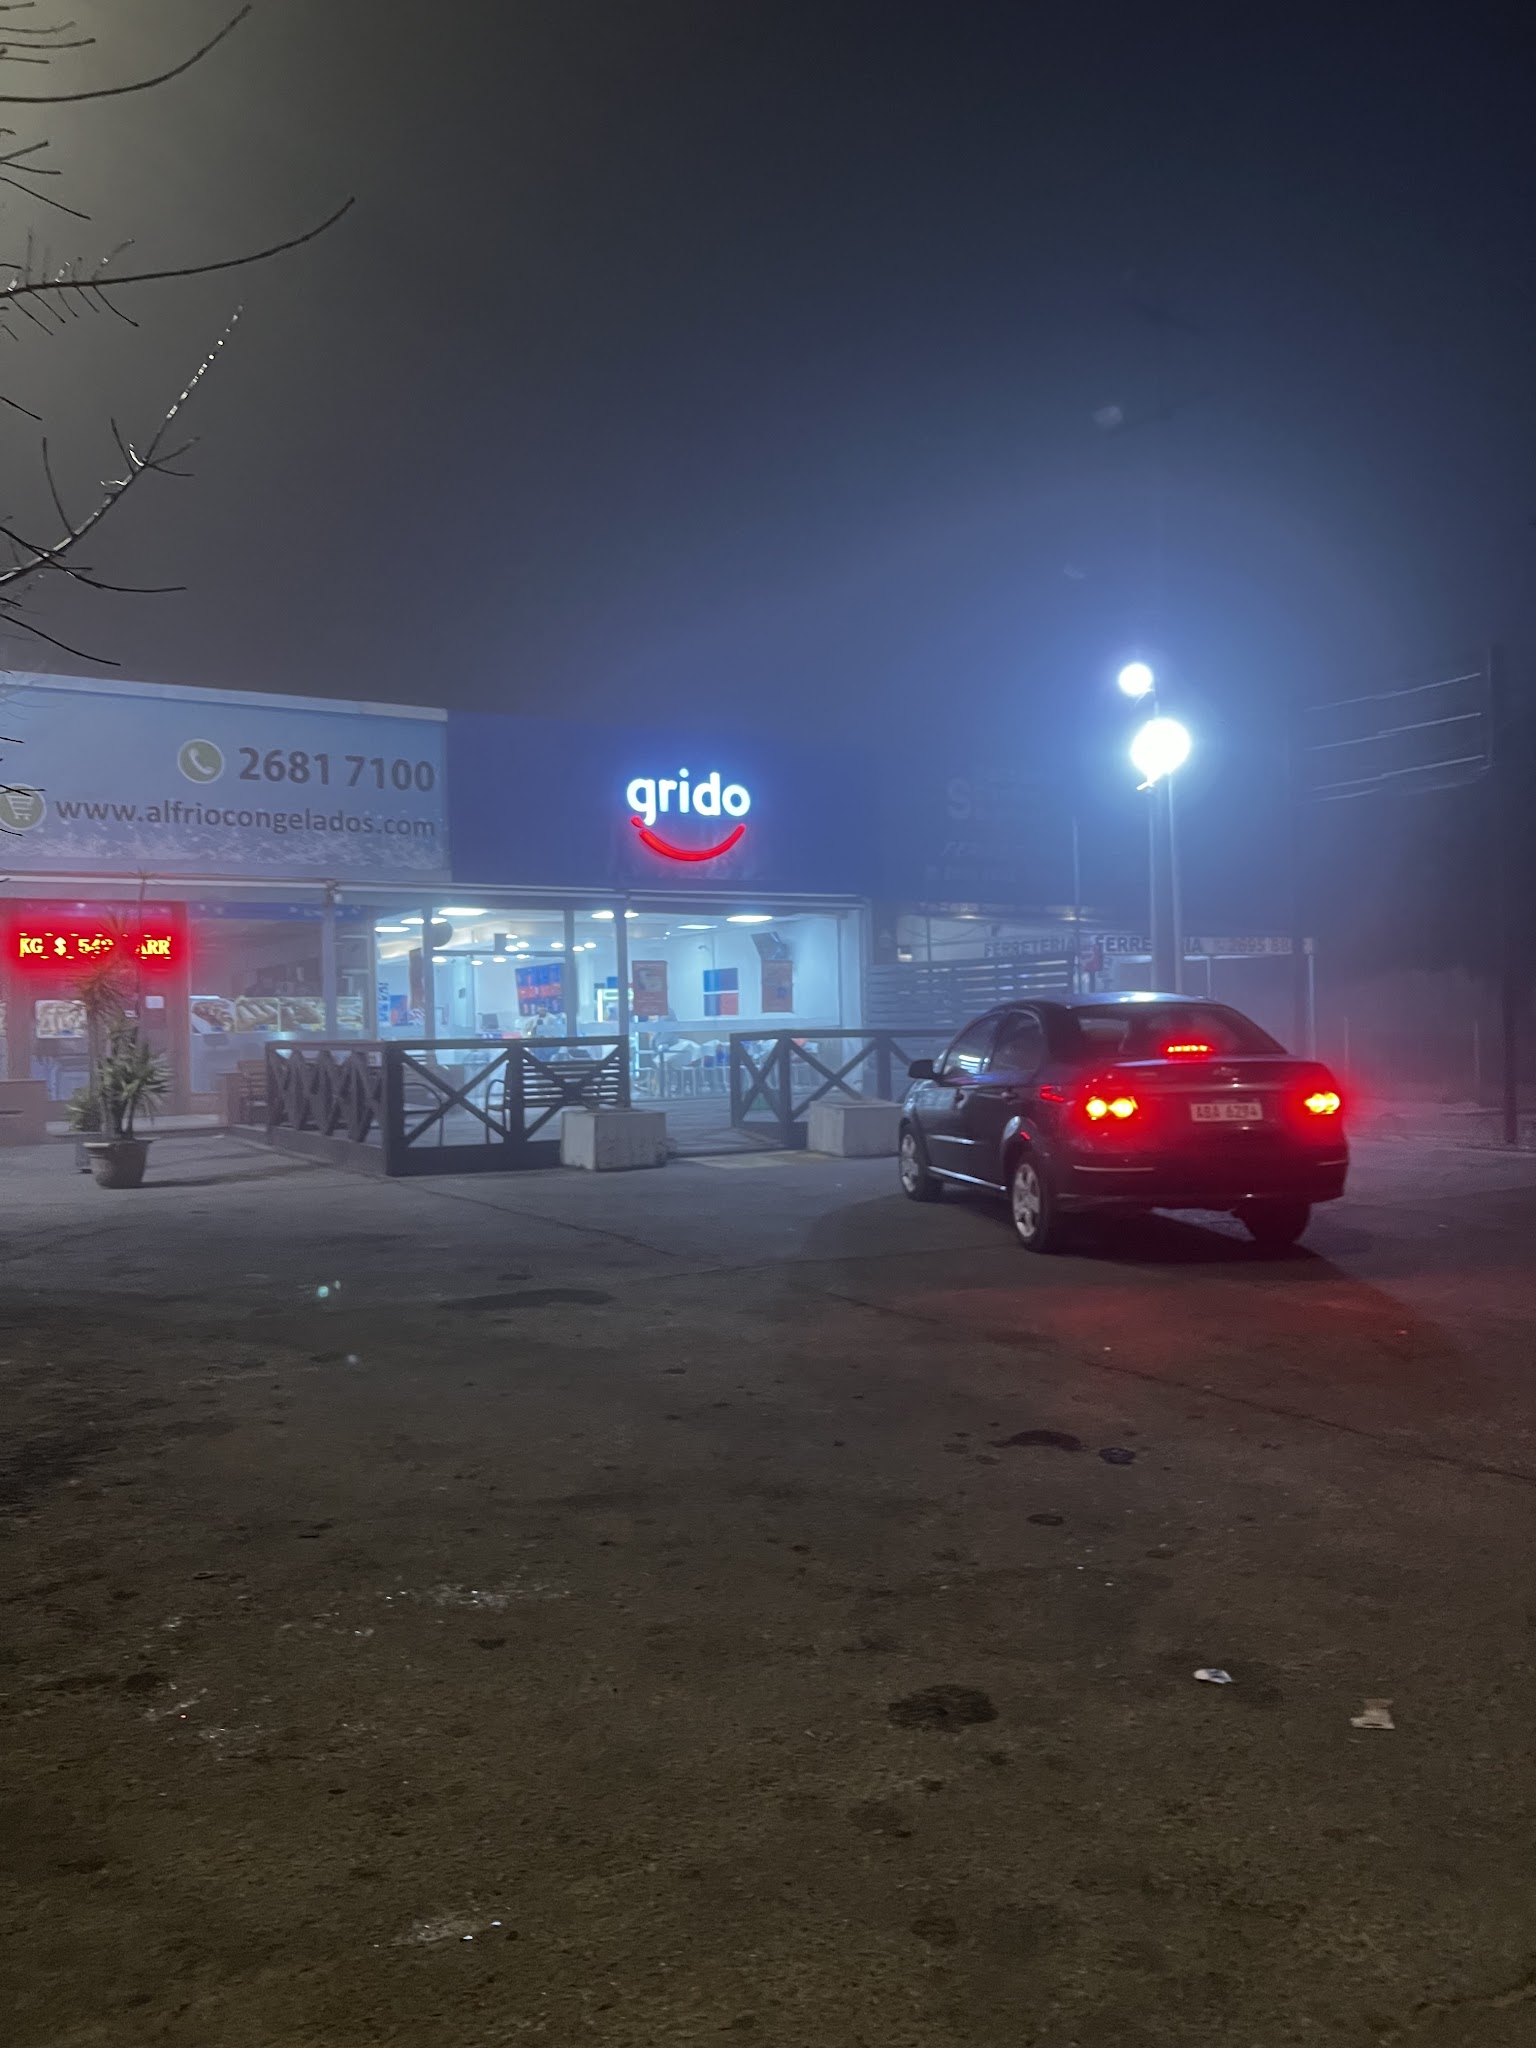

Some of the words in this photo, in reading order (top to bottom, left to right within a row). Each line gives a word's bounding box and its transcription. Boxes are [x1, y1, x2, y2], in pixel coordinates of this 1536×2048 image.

[239, 747, 330, 785] 2681
[345, 755, 435, 792] 7100
[627, 768, 751, 826] grido
[55, 799, 436, 837] www.alfriocongelados.com
[1095, 936, 1201, 953] FERREIA
